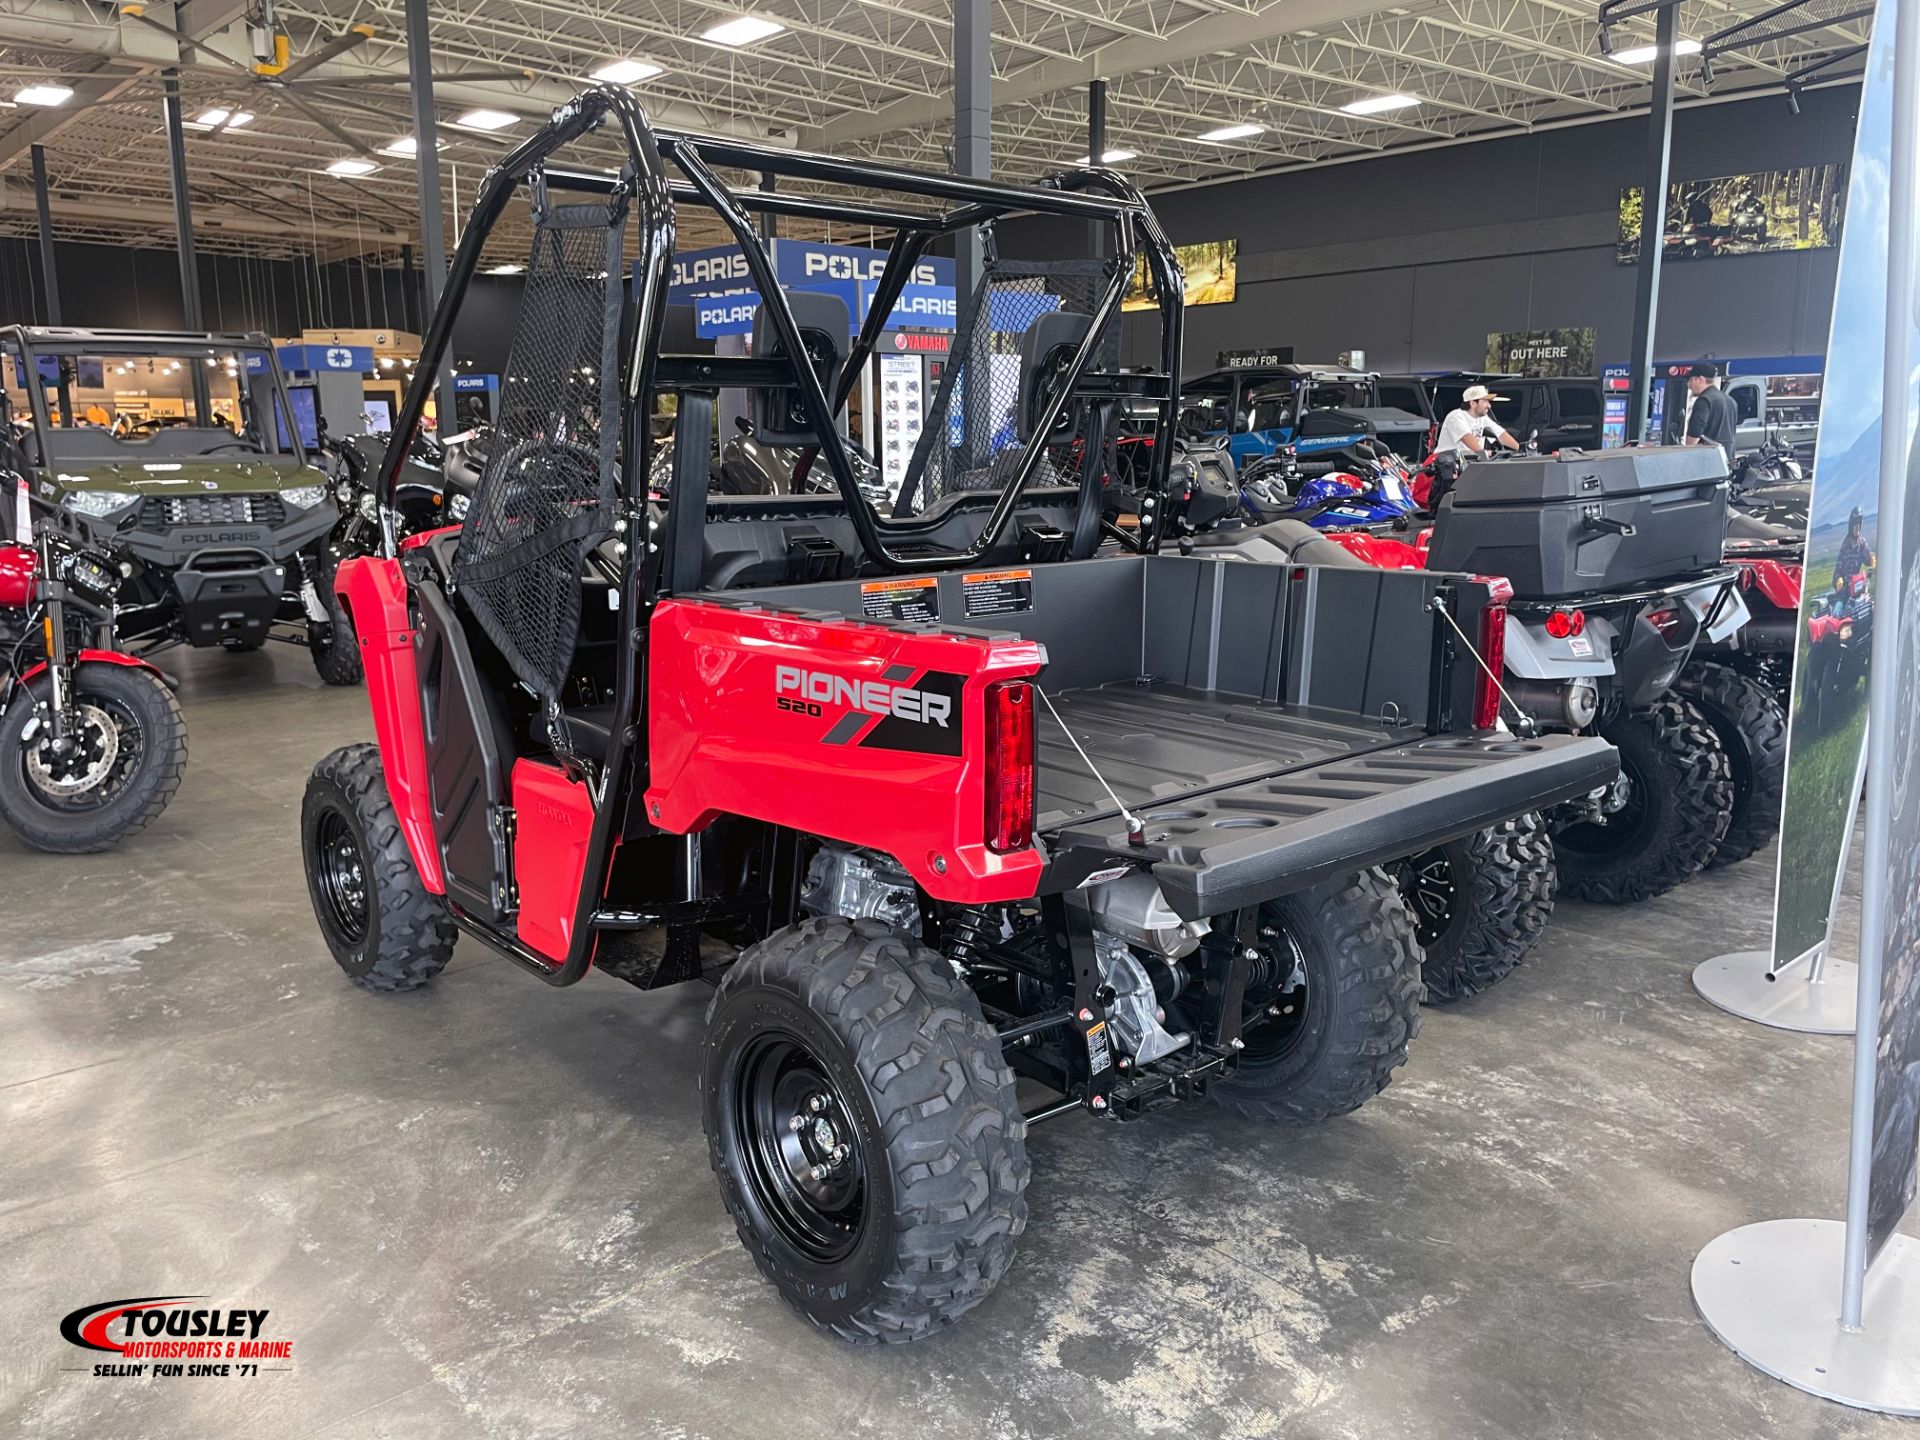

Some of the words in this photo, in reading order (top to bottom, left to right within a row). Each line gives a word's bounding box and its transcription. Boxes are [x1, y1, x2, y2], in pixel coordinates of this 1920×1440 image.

[669, 254, 750, 287] OLARIS
[805, 252, 937, 286] POLAIS
[907, 335, 948, 351] YAMAHA
[1230, 356, 1259, 367] READY
[1260, 355, 1278, 366] FOR
[1510, 348, 1534, 360] OUT
[1536, 346, 1568, 359] HERE
[457, 379, 484, 387] POLARIS
[181, 531, 262, 544] POLARIS
[889, 580, 916, 589] WARNING
[775, 664, 952, 728] PIONEER
[776, 697, 822, 718] 520
[537, 801, 573, 826] HONDA
